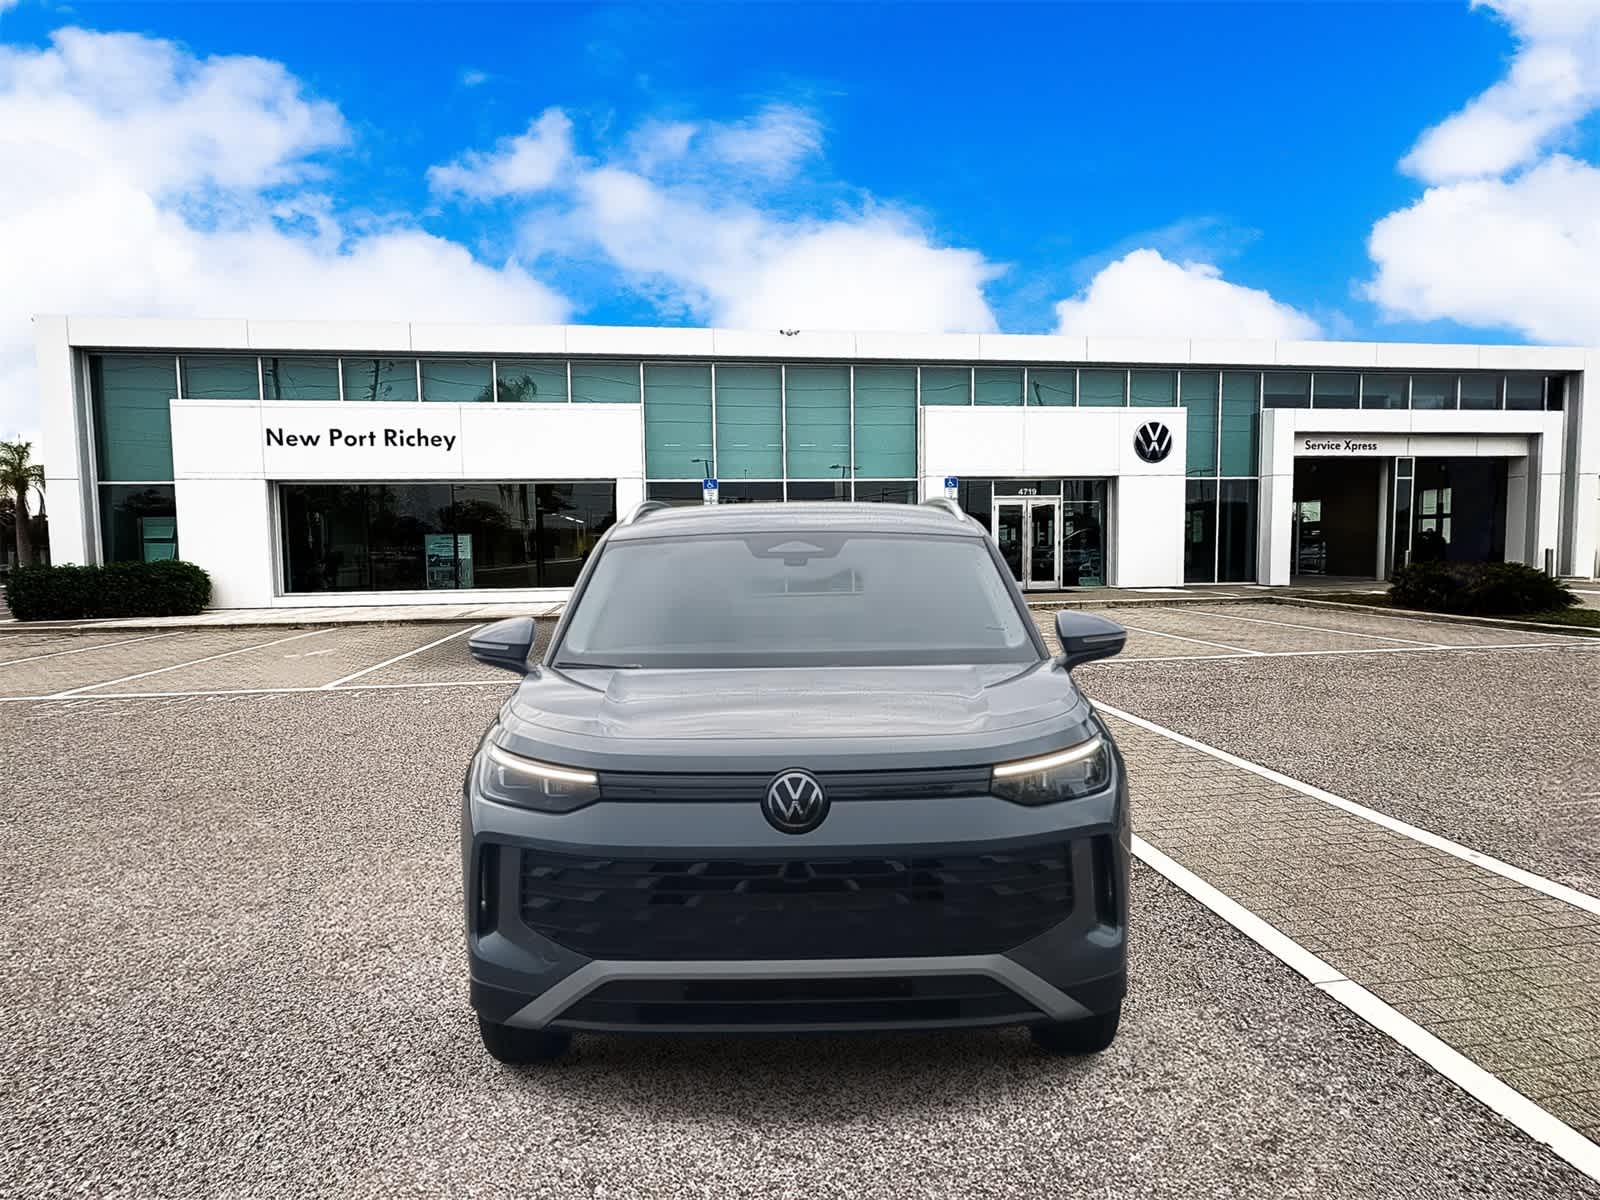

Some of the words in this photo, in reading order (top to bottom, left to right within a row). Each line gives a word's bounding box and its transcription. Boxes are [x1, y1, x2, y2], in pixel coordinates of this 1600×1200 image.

[265, 427, 321, 447] New
[329, 428, 376, 447] Port
[384, 428, 456, 451] Richey
[1305, 440, 1341, 451] Service
[1344, 440, 1377, 453] Xpress
[1018, 488, 1037, 496] 4719
